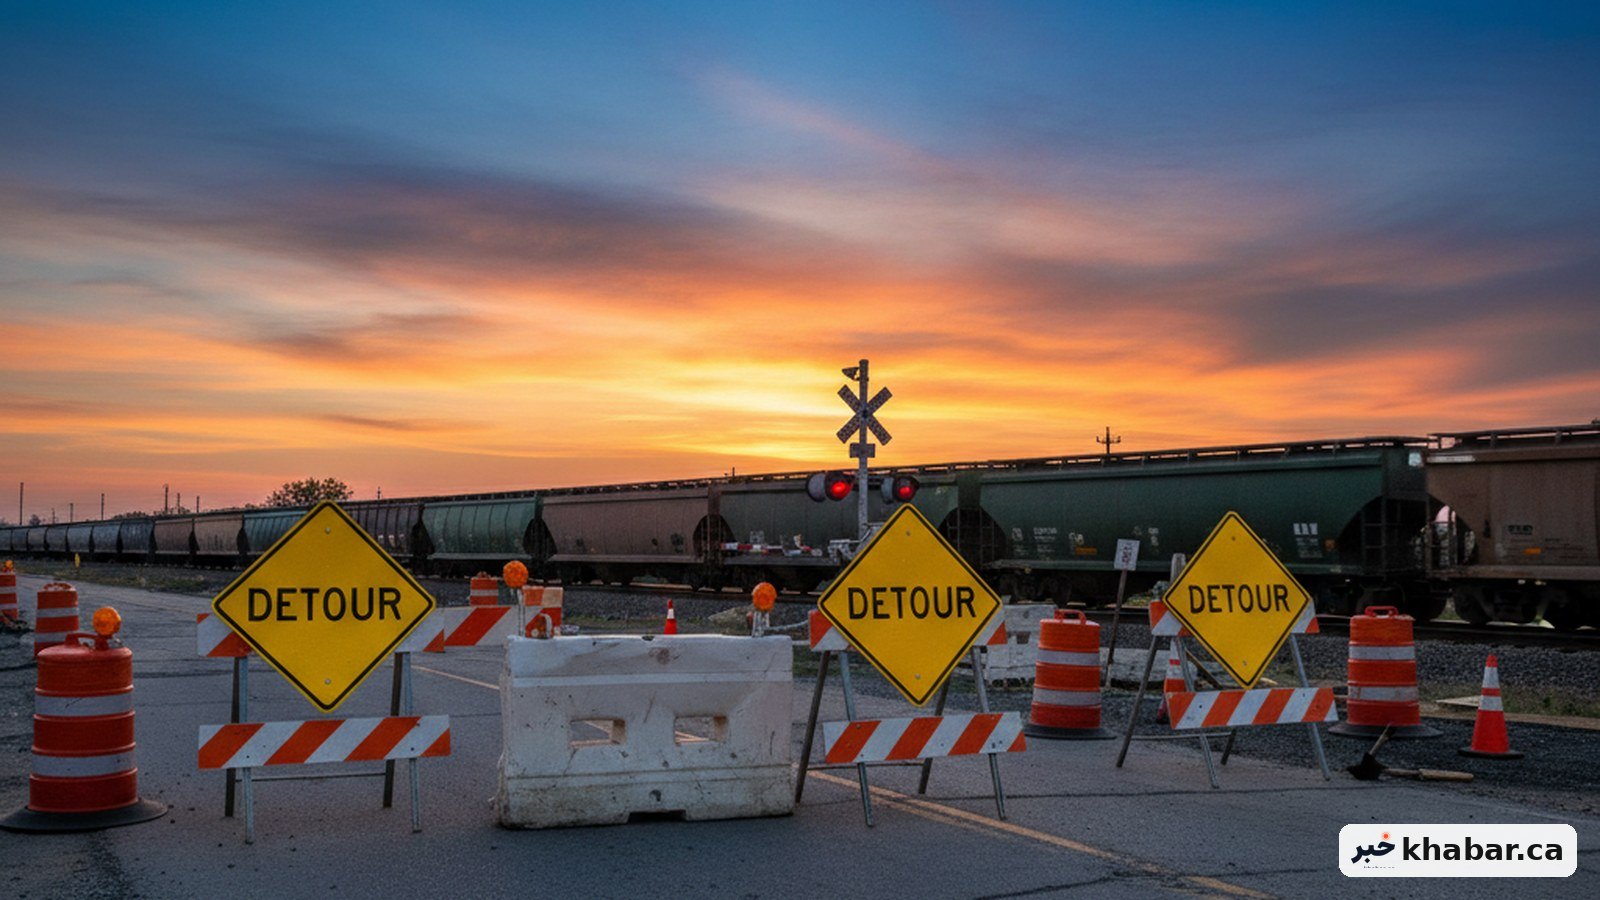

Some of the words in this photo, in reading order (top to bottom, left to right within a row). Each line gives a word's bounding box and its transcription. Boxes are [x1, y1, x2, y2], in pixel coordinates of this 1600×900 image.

[248, 587, 401, 622] DETOUR
[848, 586, 977, 620] DETOUR
[1188, 584, 1291, 614] DETOUR
